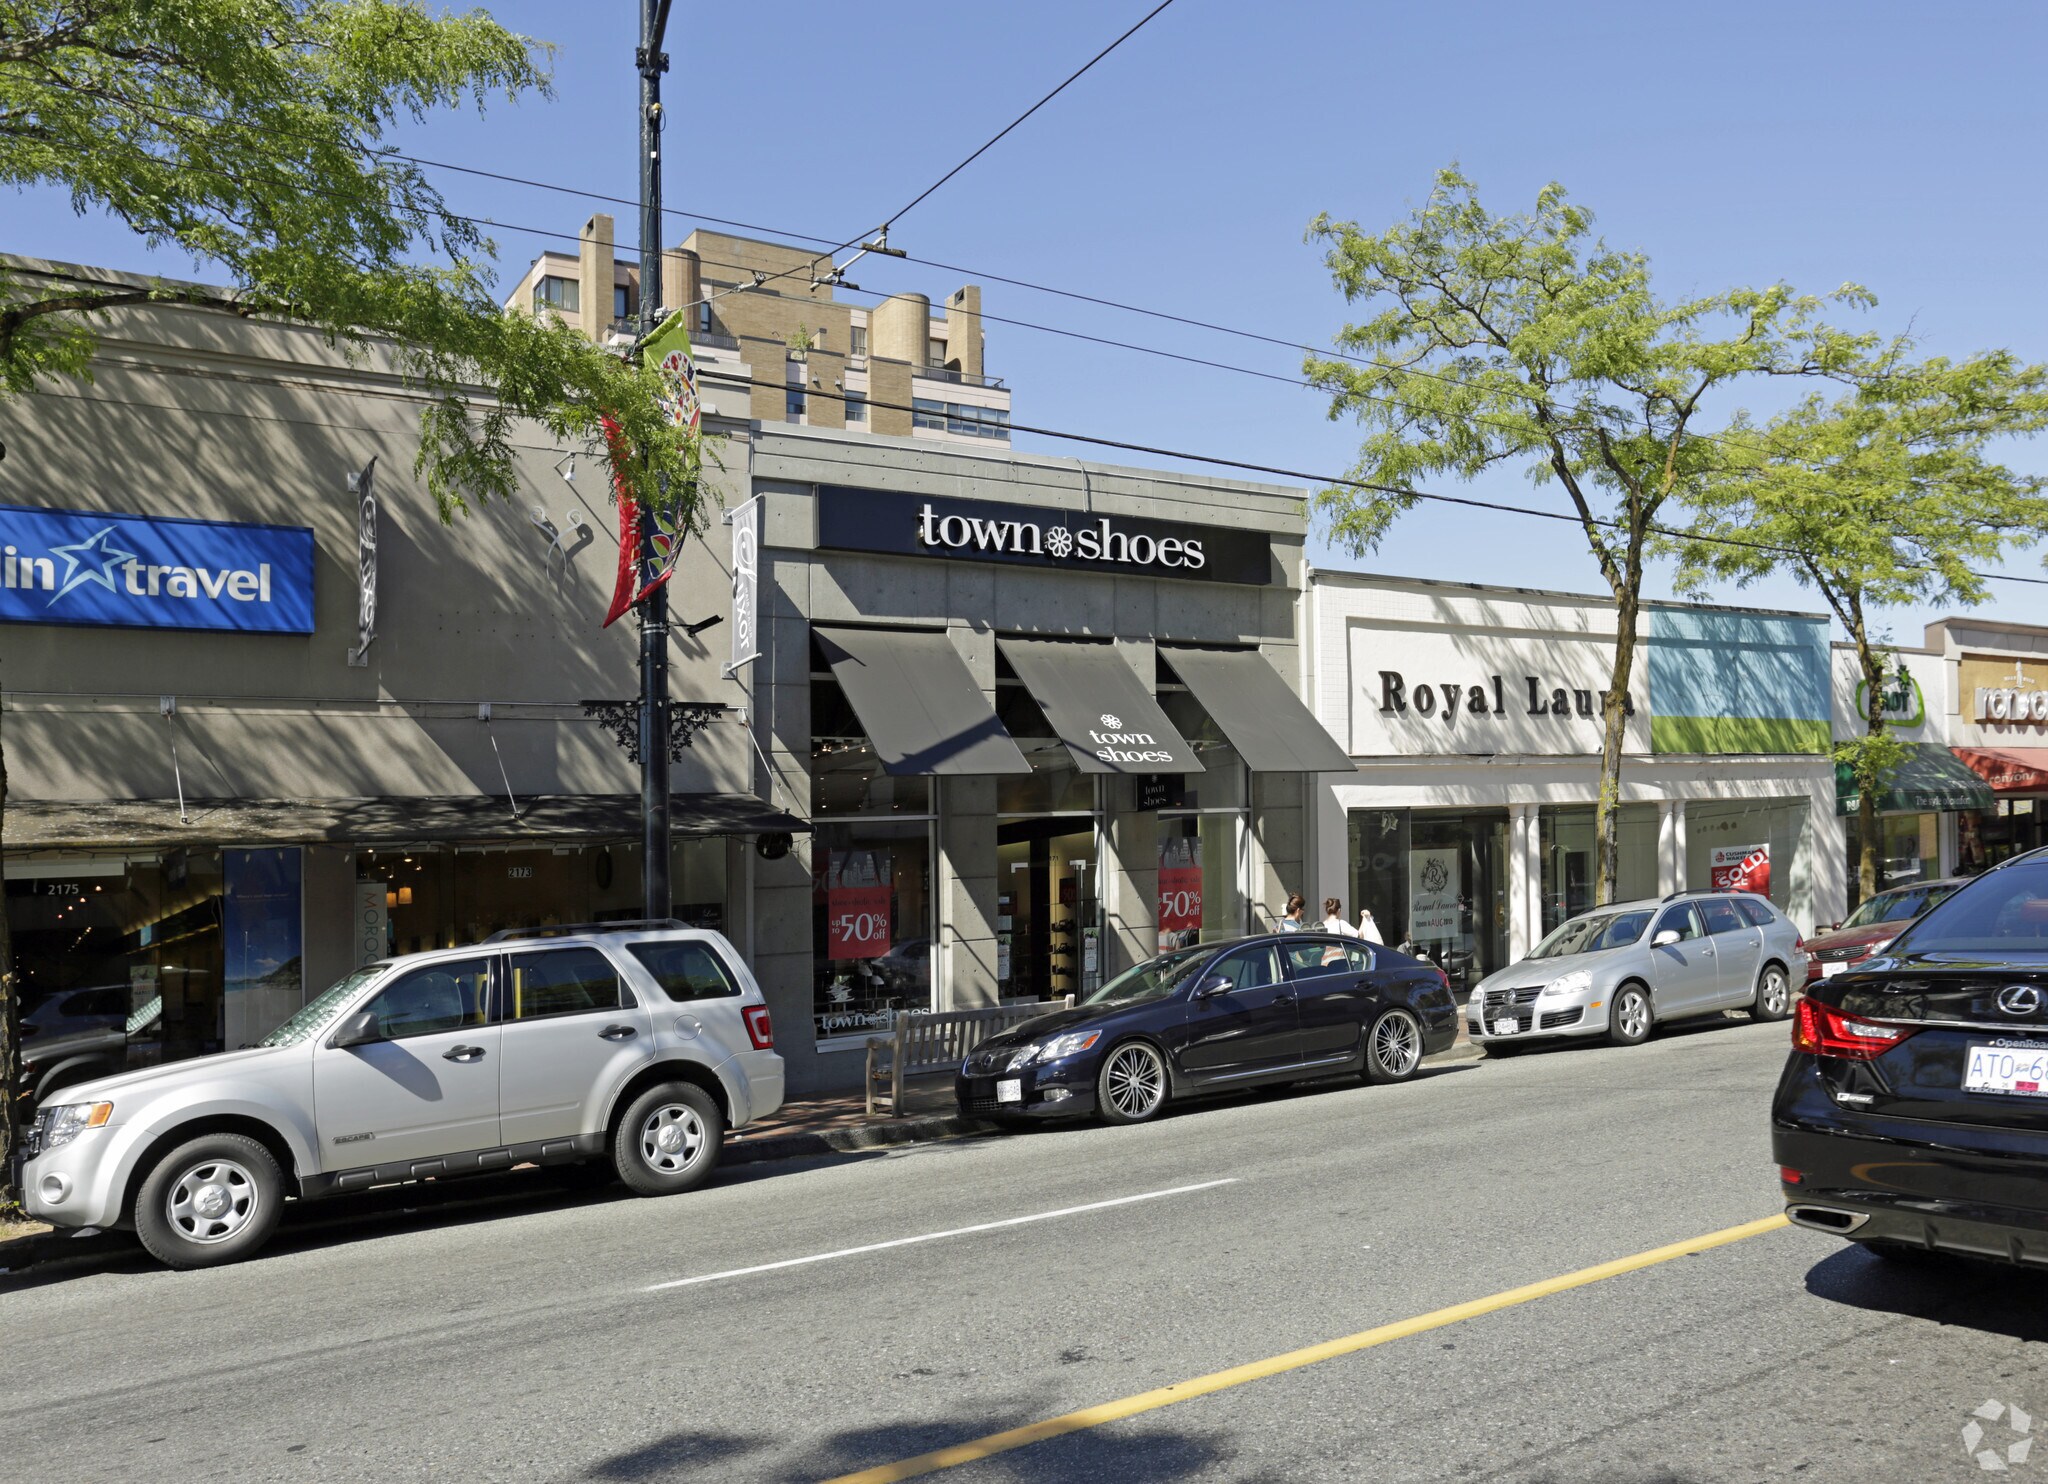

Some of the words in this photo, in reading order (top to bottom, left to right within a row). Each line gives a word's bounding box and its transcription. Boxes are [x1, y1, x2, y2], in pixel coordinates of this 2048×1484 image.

[919, 503, 1044, 555] town
[1076, 518, 1205, 569] shoes
[0, 545, 54, 590] in
[121, 558, 271, 603] travel
[1378, 671, 1505, 721] Royal
[1974, 687, 2048, 721] ronso
[1089, 730, 1156, 745] town
[1096, 746, 1173, 762] shoes
[1145, 784, 1165, 795] town
[1143, 797, 1167, 807] shoes
[1915, 795, 1927, 806] The
[508, 867, 532, 878] 2173
[1718, 851, 1764, 888] SOLD
[48, 884, 79, 895] 2175
[1189, 905, 1200, 916] off
[1412, 900, 1436, 915] Royal
[832, 920, 841, 929] up
[841, 913, 887, 942] 50%
[1431, 918, 1444, 927] AUG
[873, 928, 886, 940] off
[821, 1012, 866, 1030] town
[878, 1006, 930, 1024] shes
[1996, 1039, 2048, 1049] OpenRoa
[1970, 1054, 2014, 1079] ATO
[1969, 1086, 2005, 1094] LEXUS
[335, 1133, 370, 1144] ESCAPE
